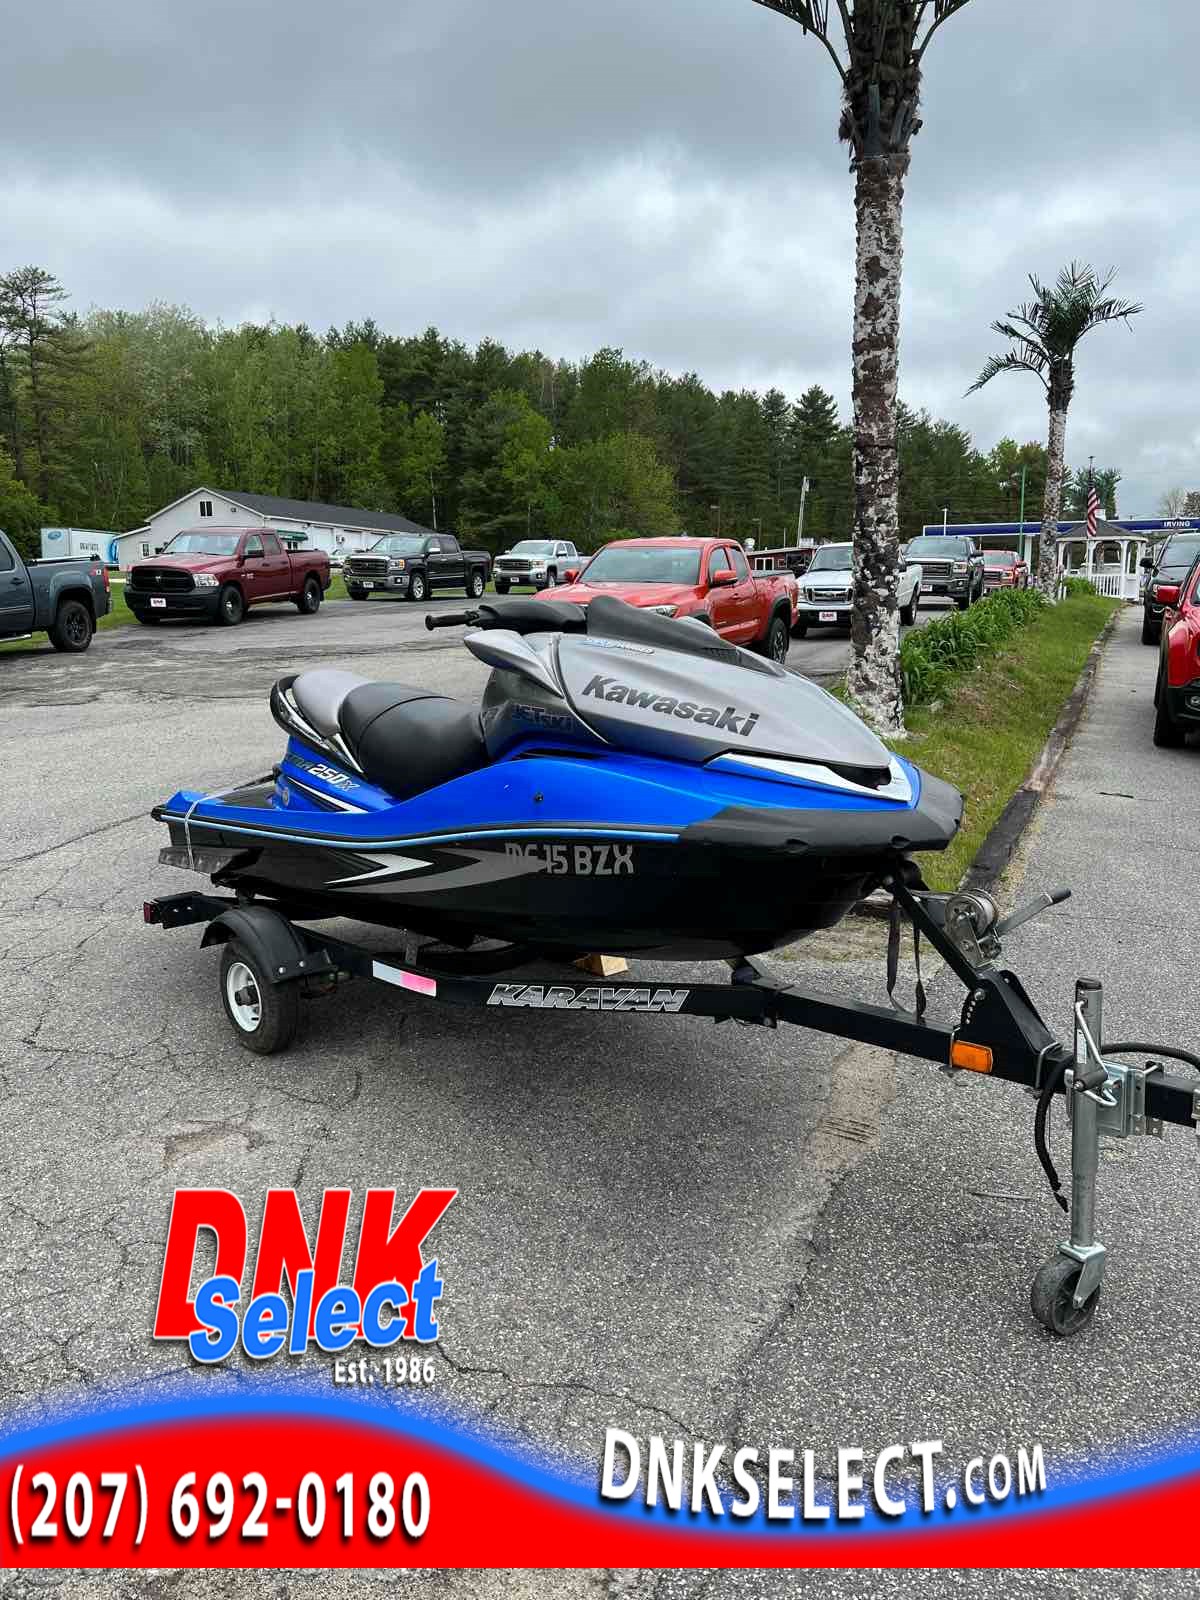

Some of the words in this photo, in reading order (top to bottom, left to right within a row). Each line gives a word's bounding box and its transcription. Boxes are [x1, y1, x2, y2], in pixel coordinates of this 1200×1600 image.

[1163, 520, 1191, 528] IRVING
[582, 675, 760, 736] Kawasaki
[574, 844, 635, 875] BZX
[486, 984, 690, 1012] KARAVAN
